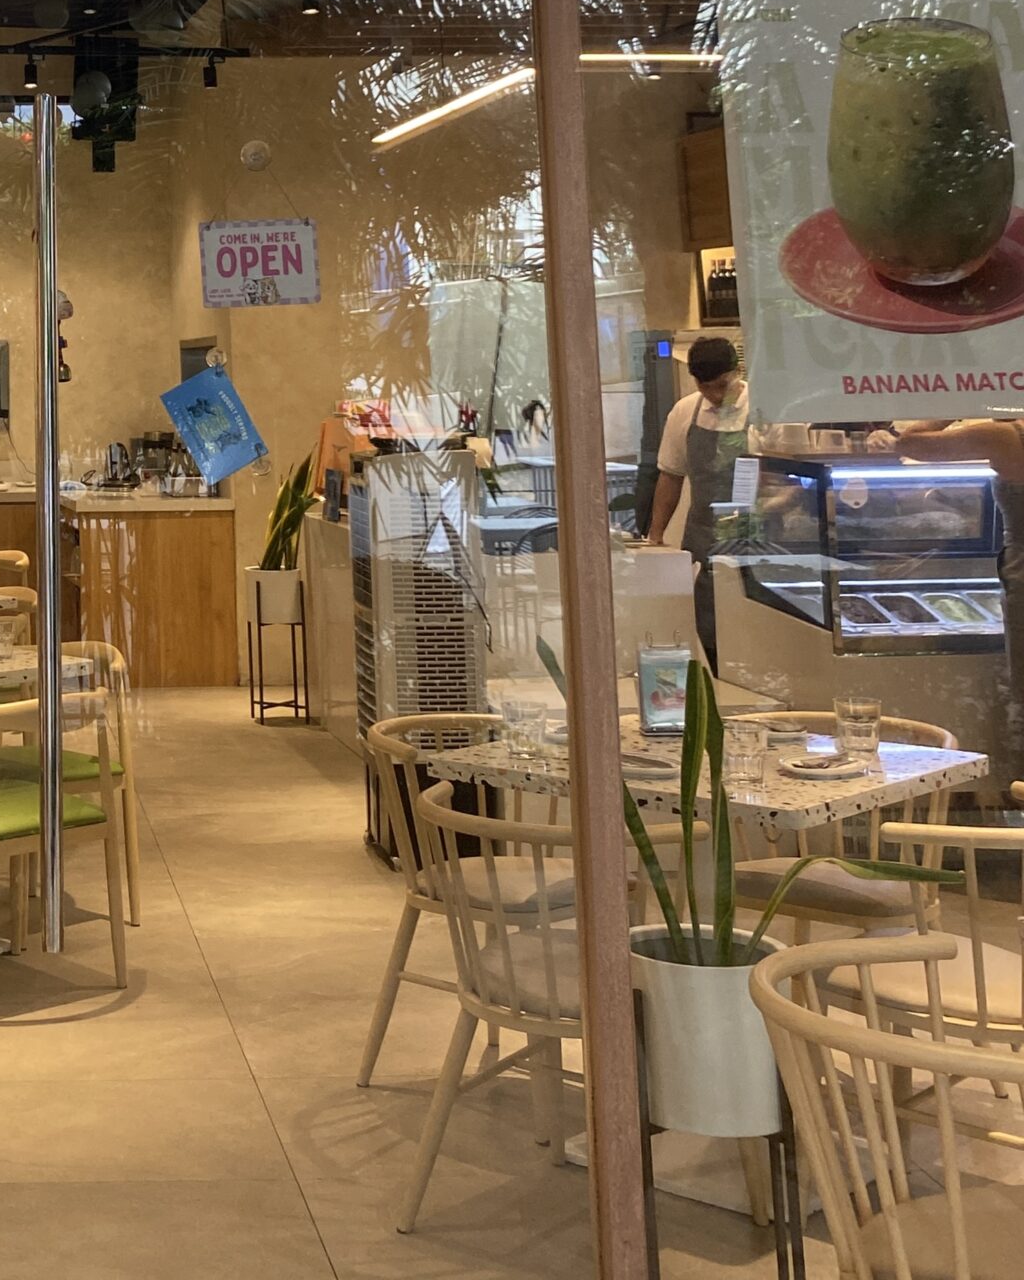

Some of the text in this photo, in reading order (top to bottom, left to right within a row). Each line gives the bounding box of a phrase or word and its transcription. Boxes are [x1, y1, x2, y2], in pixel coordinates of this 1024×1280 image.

[219, 233, 248, 245] COME
[250, 232, 264, 245] IN,
[216, 243, 303, 278] OPEN
[842, 374, 949, 395] BANANA
